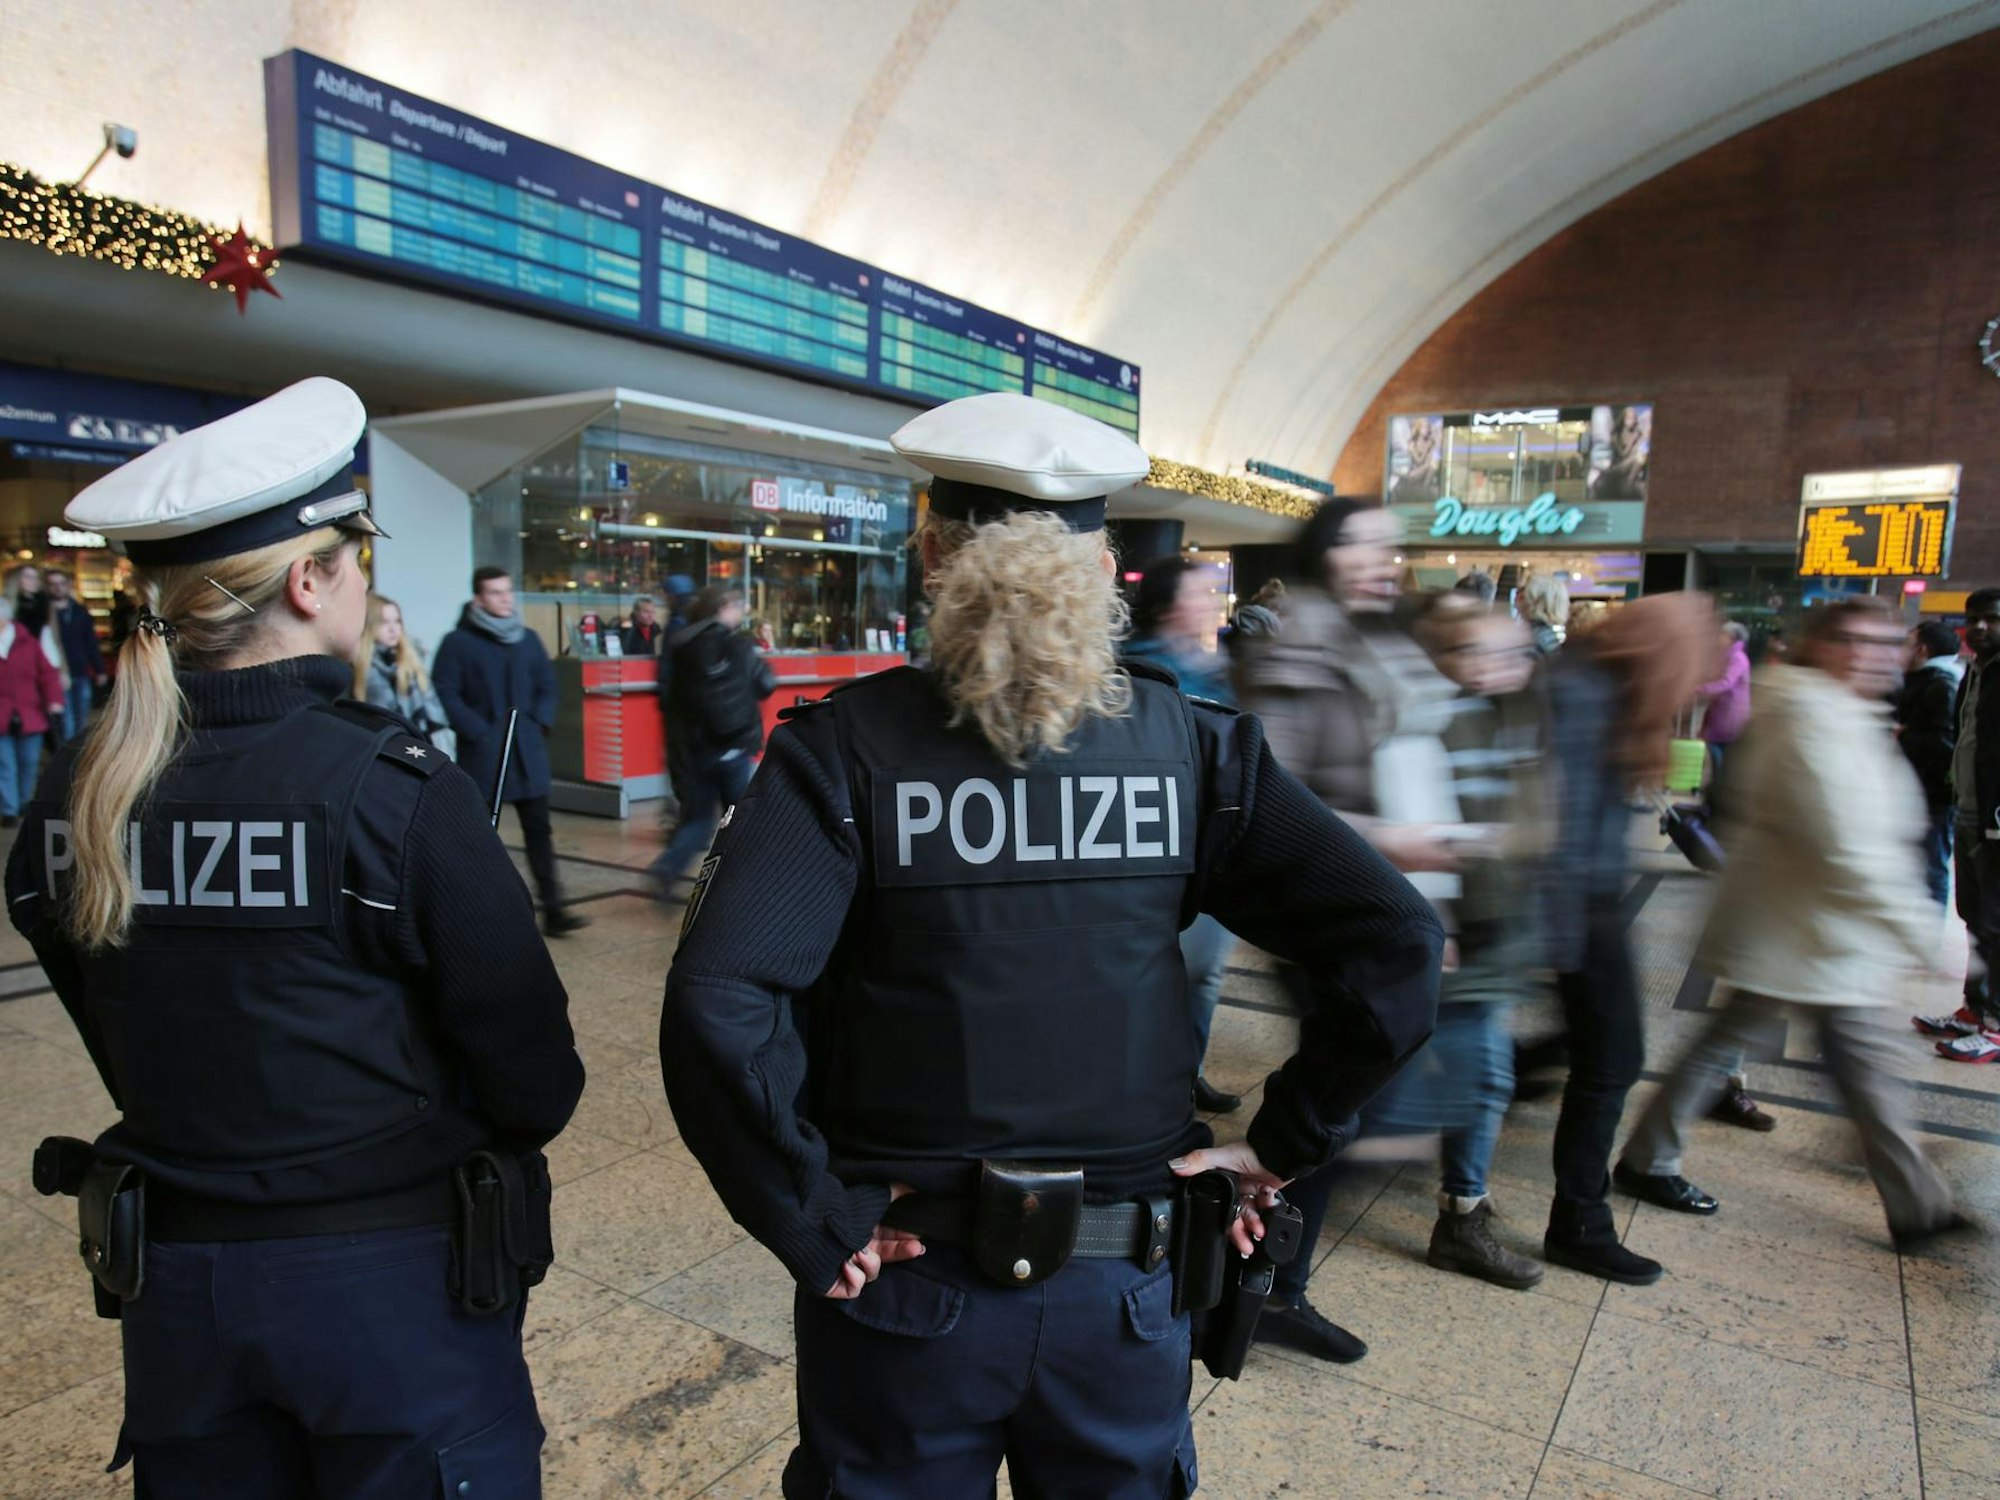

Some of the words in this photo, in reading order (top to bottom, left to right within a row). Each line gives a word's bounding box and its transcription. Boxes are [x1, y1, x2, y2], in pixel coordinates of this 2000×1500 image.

[314, 68, 384, 112] Abfahrt
[389, 99, 457, 138] Departure
[755, 483, 778, 508] DB
[786, 486, 888, 522] Information
[1429, 491, 1585, 547] Douglas
[896, 776, 1181, 867] POLIZEI
[44, 818, 310, 908] PLIZEI
